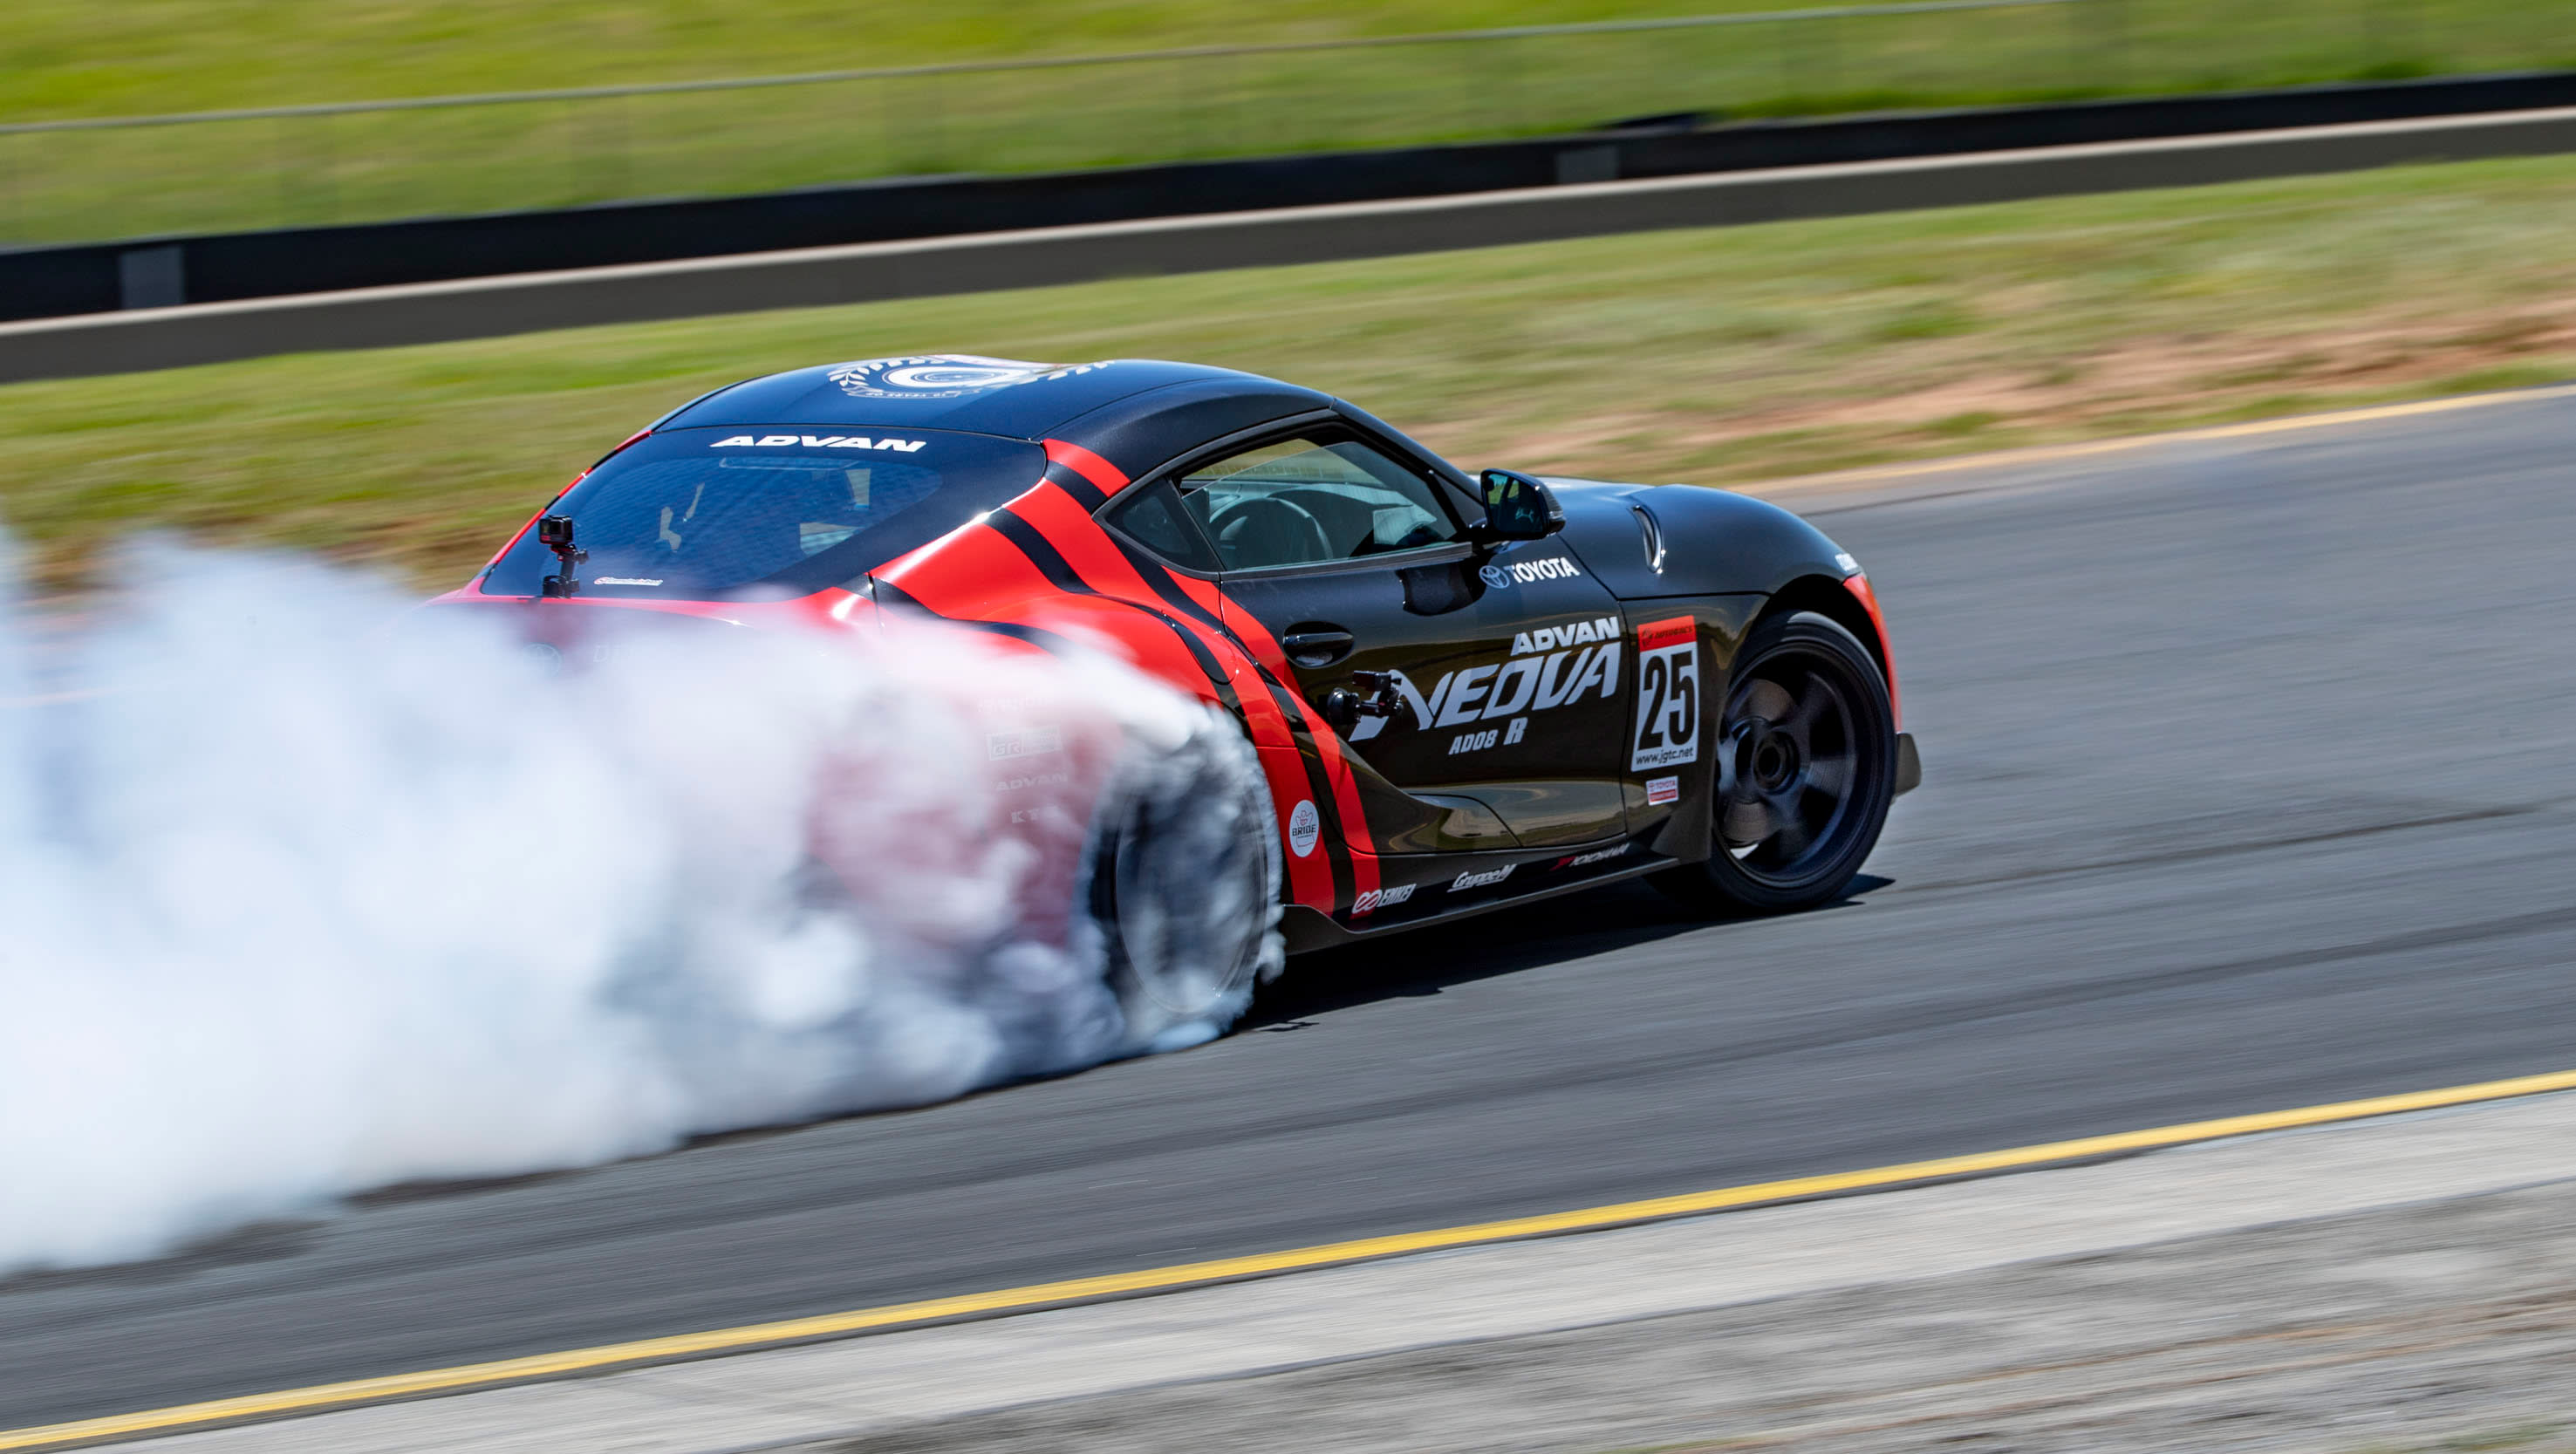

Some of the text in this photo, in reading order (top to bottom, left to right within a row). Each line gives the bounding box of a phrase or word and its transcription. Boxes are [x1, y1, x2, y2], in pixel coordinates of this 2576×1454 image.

[710, 435, 926, 453] ADVAN
[1509, 556, 1580, 583] TOYOTA
[1511, 616, 1621, 657] ADVAN
[1349, 642, 1622, 741] NEOVA
[1637, 651, 1695, 751] 25
[1449, 718, 1528, 755] AD08 R
[1636, 747, 1694, 765] www.jgtc.net
[995, 773, 1069, 792] ADVAN
[1292, 824, 1317, 836] BRIDE
